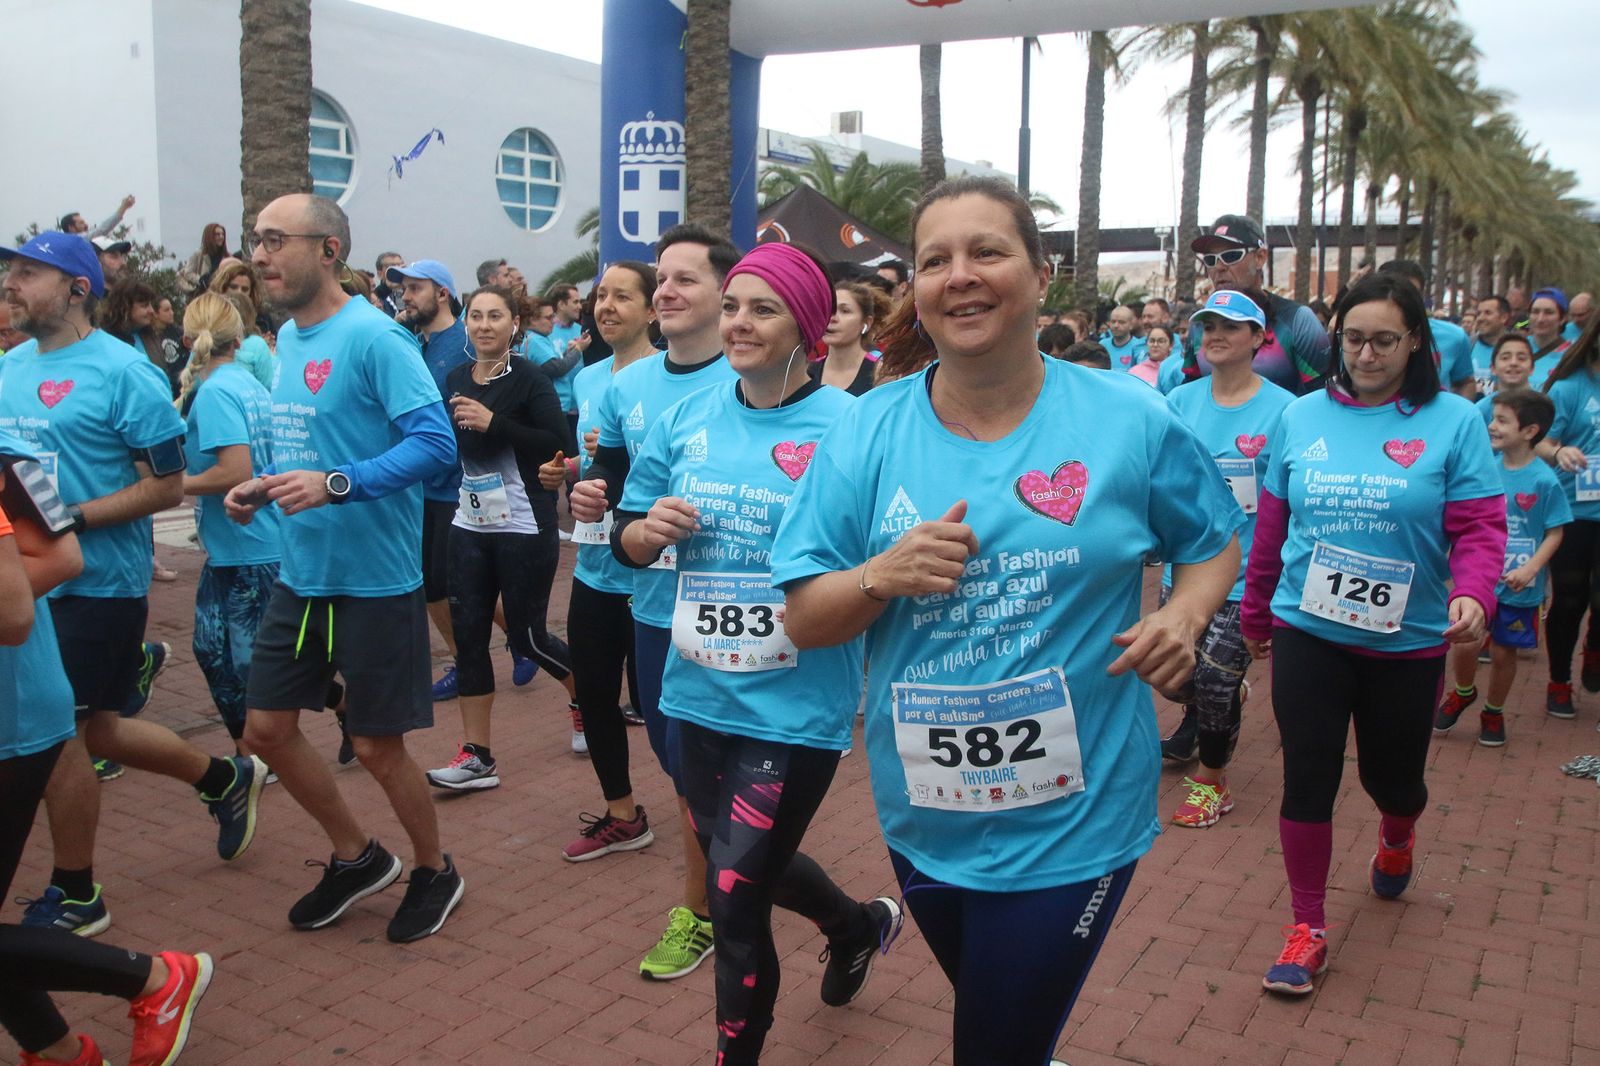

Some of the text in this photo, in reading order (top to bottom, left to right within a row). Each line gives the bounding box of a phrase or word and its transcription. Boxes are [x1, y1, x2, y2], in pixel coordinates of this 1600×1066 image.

[683, 445, 708, 456] ALTEA
[1300, 449, 1328, 458] ALTEA
[680, 472, 689, 494] I
[690, 476, 737, 496] Runner
[1313, 471, 1357, 484] Runner
[1361, 473, 1408, 489] Fashion
[1307, 483, 1388, 499] Carrera azul
[470, 493, 480, 509] 8
[685, 494, 769, 521] Carrera azul
[1304, 496, 1390, 511] por el autismo
[701, 512, 772, 536] el autismo
[880, 514, 922, 535] ALTEA
[1321, 519, 1352, 536] nada
[1351, 518, 1367, 529] te
[1368, 519, 1400, 536] pare
[733, 535, 757, 546] Marzo
[744, 548, 772, 567] par
[998, 545, 1080, 573] Fashion
[690, 578, 709, 587] Runner
[710, 580, 735, 589] Fashion
[740, 581, 771, 589] Carrera
[1006, 570, 1048, 597] azul
[1326, 572, 1392, 607] 126
[686, 591, 696, 600] por
[697, 590, 706, 600] el
[706, 590, 737, 601] autismo
[913, 594, 1053, 630] por el autismo
[1337, 599, 1369, 614] ARANCHA
[695, 603, 775, 637] 583
[969, 625, 995, 637] 31de
[1000, 620, 1034, 634] Marzo
[703, 637, 712, 649] LA
[904, 661, 940, 684] Que
[943, 641, 991, 673] nada
[989, 634, 1016, 656] te
[904, 679, 1053, 706] I Runner Fashion Carrera azul
[905, 712, 921, 722] por
[924, 711, 937, 723] el
[939, 709, 985, 723] autismo
[928, 718, 1047, 768] 582
[960, 766, 1018, 786] THYBAIRE
[1072, 873, 1114, 938] Joma
